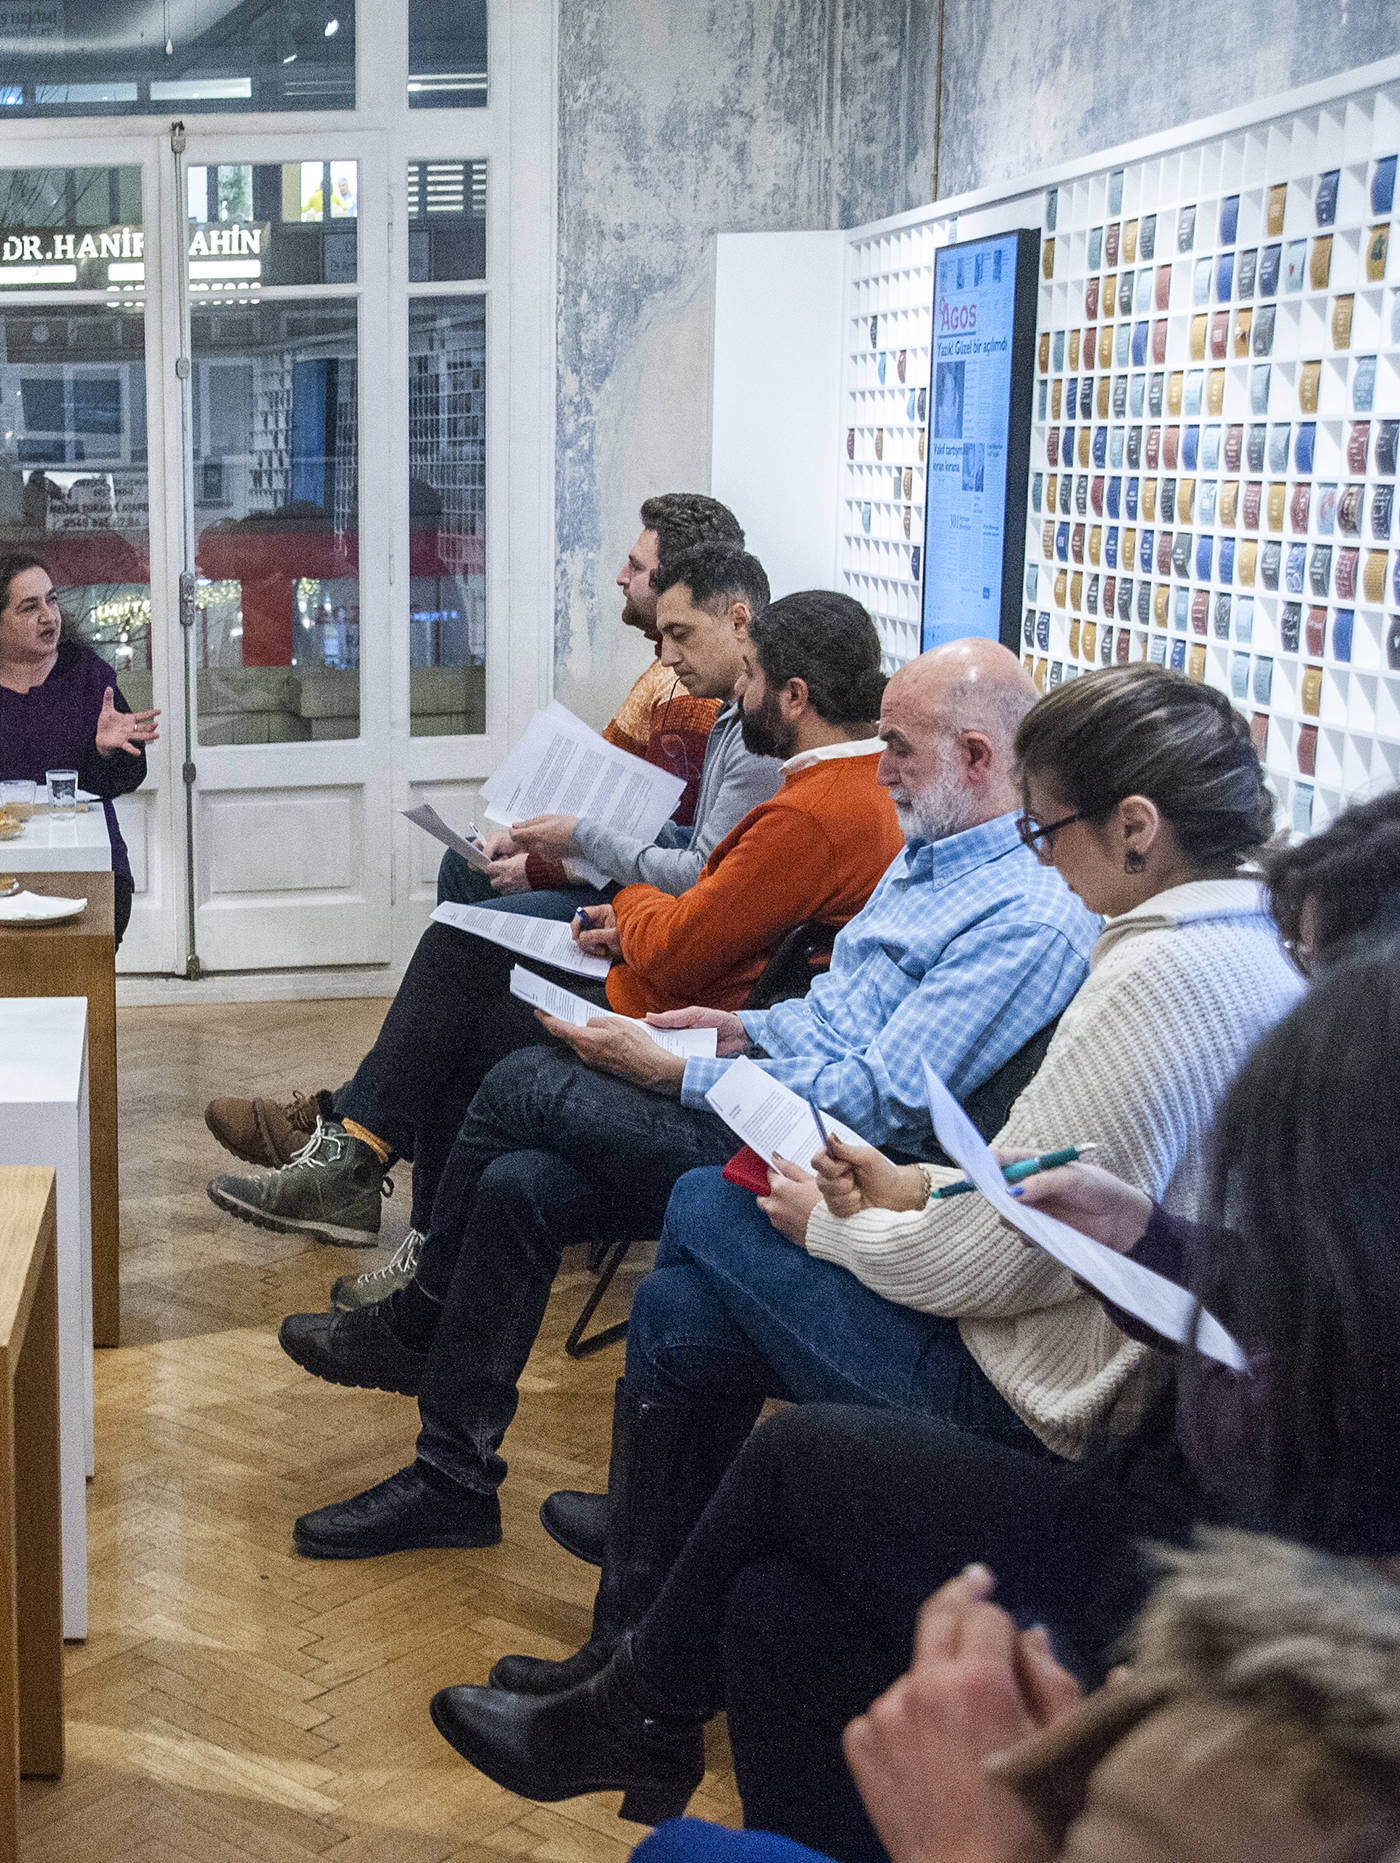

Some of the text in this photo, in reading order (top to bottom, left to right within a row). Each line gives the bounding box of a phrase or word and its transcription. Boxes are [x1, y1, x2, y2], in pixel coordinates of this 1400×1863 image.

[189, 224, 261, 256] AHİN
[939, 299, 977, 331] AGOS
[955, 340, 972, 356] Güzel
[973, 338, 981, 354] bir
